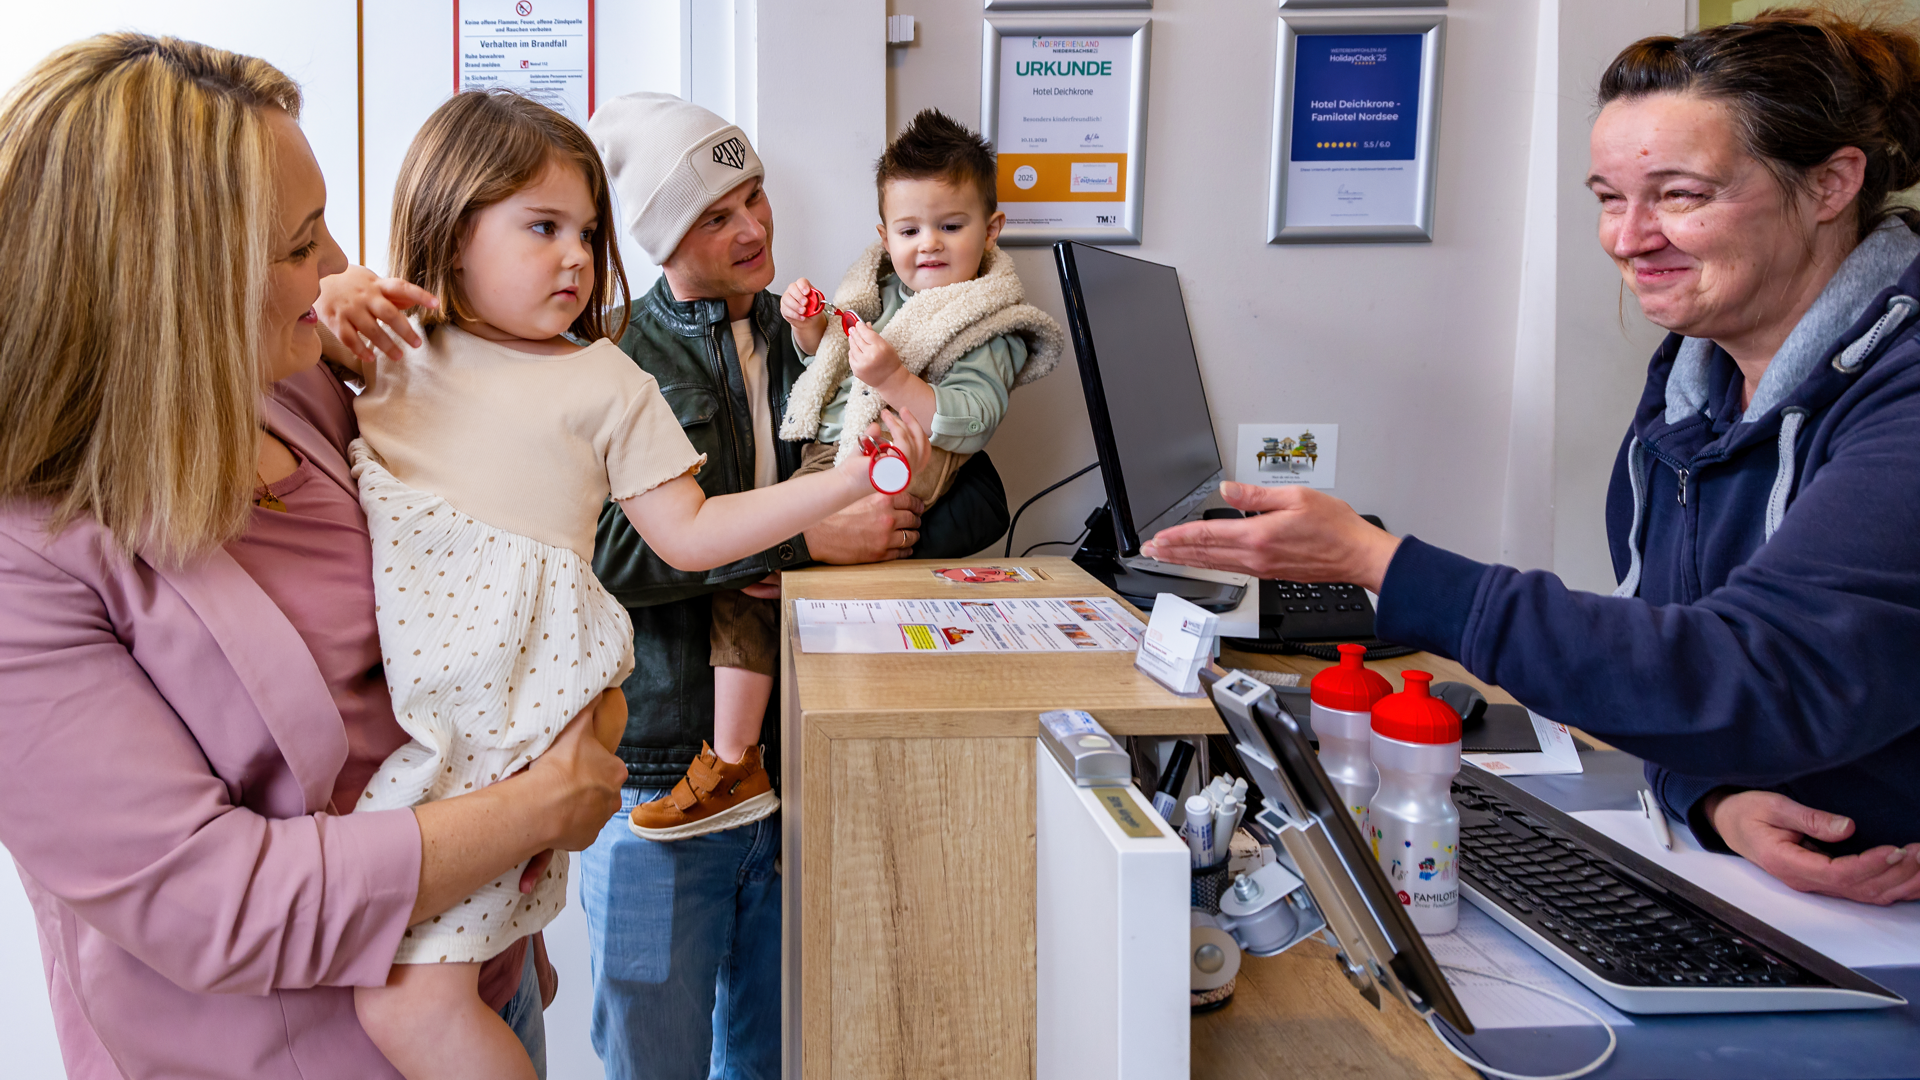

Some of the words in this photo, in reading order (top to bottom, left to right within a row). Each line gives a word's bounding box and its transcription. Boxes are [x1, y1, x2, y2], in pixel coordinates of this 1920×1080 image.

[480, 40, 518, 48] Verhalten
[531, 39, 568, 47] Brandfall
[1032, 38, 1100, 48] KINDERFERIENLAND
[1330, 54, 1375, 63] HolidayCheck
[1016, 61, 1112, 76] URKUNDE
[1053, 88, 1094, 96] Deichkrone
[1311, 100, 1337, 108] Hotel
[1339, 100, 1395, 108] Deichkrone
[1311, 113, 1356, 121] Familotel
[1358, 112, 1399, 120] Nordsee
[713, 137, 745, 169] PAPA
[1017, 174, 1034, 182] 2025
